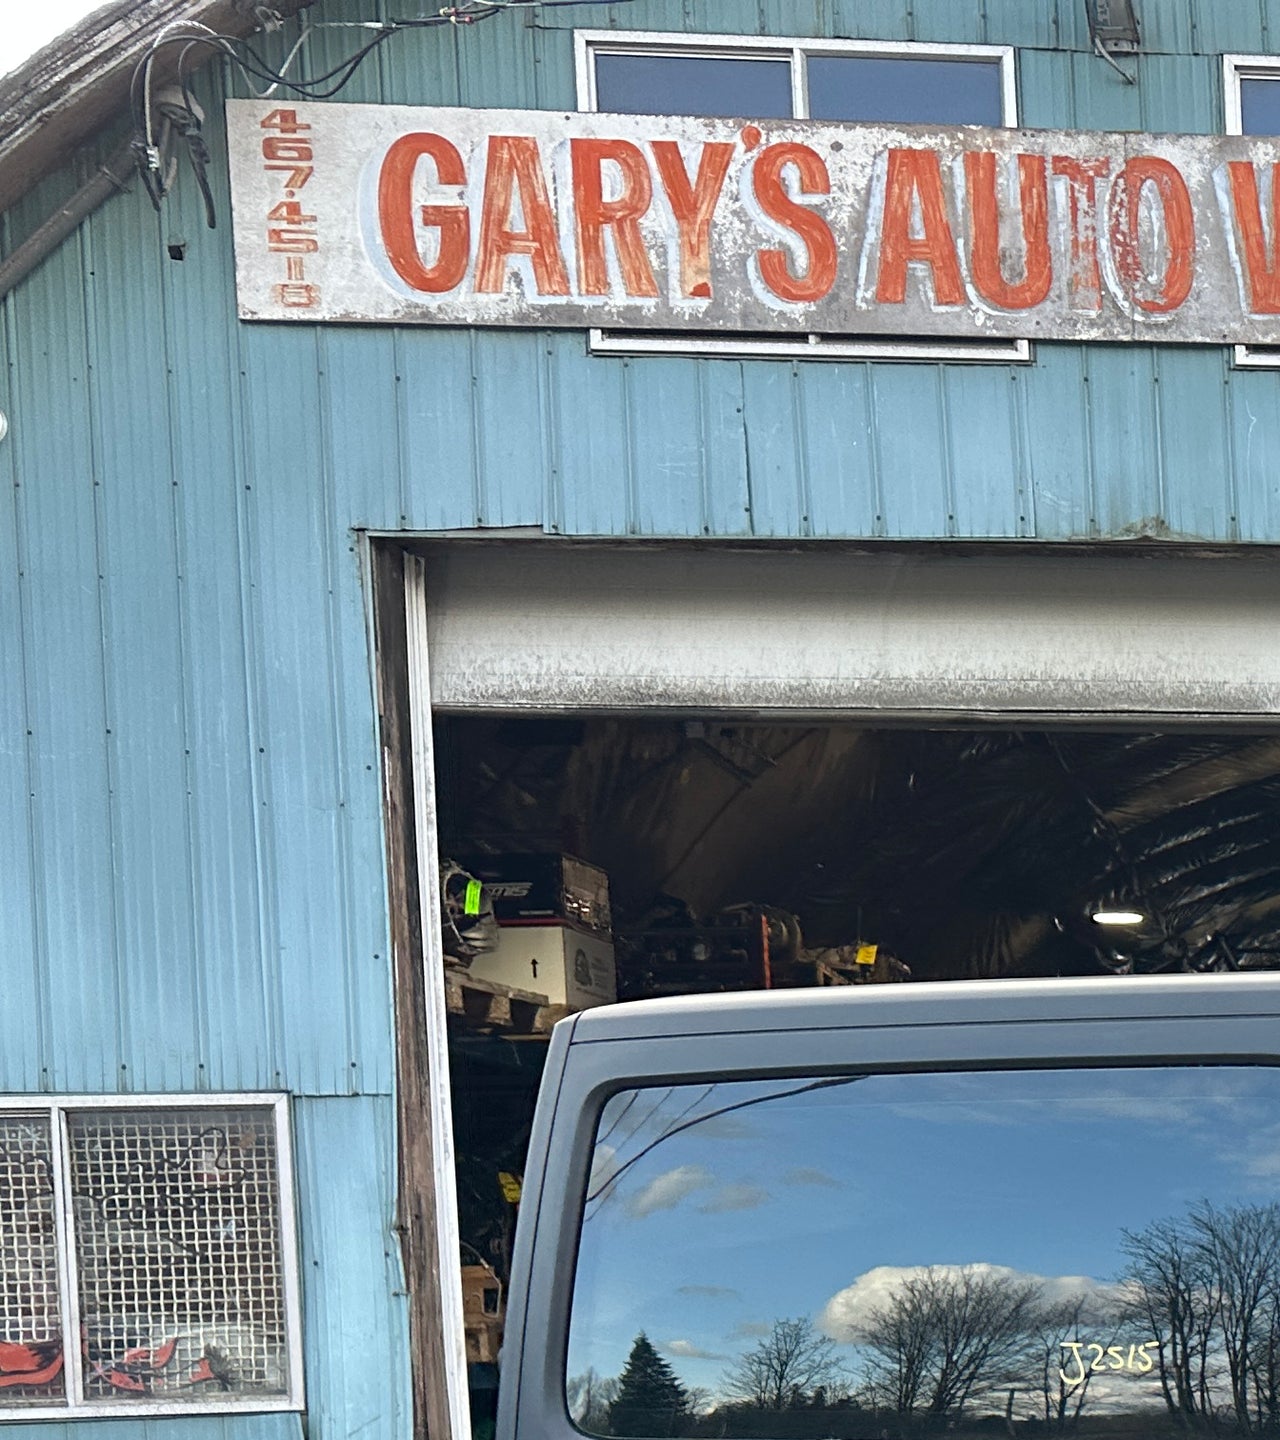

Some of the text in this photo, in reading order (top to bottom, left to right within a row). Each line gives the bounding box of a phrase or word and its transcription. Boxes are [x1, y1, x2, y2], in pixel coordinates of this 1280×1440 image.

[378, 126, 839, 304] GARY'S
[875, 149, 1196, 314] AUTO
[1059, 1341, 1159, 1385] J2515
